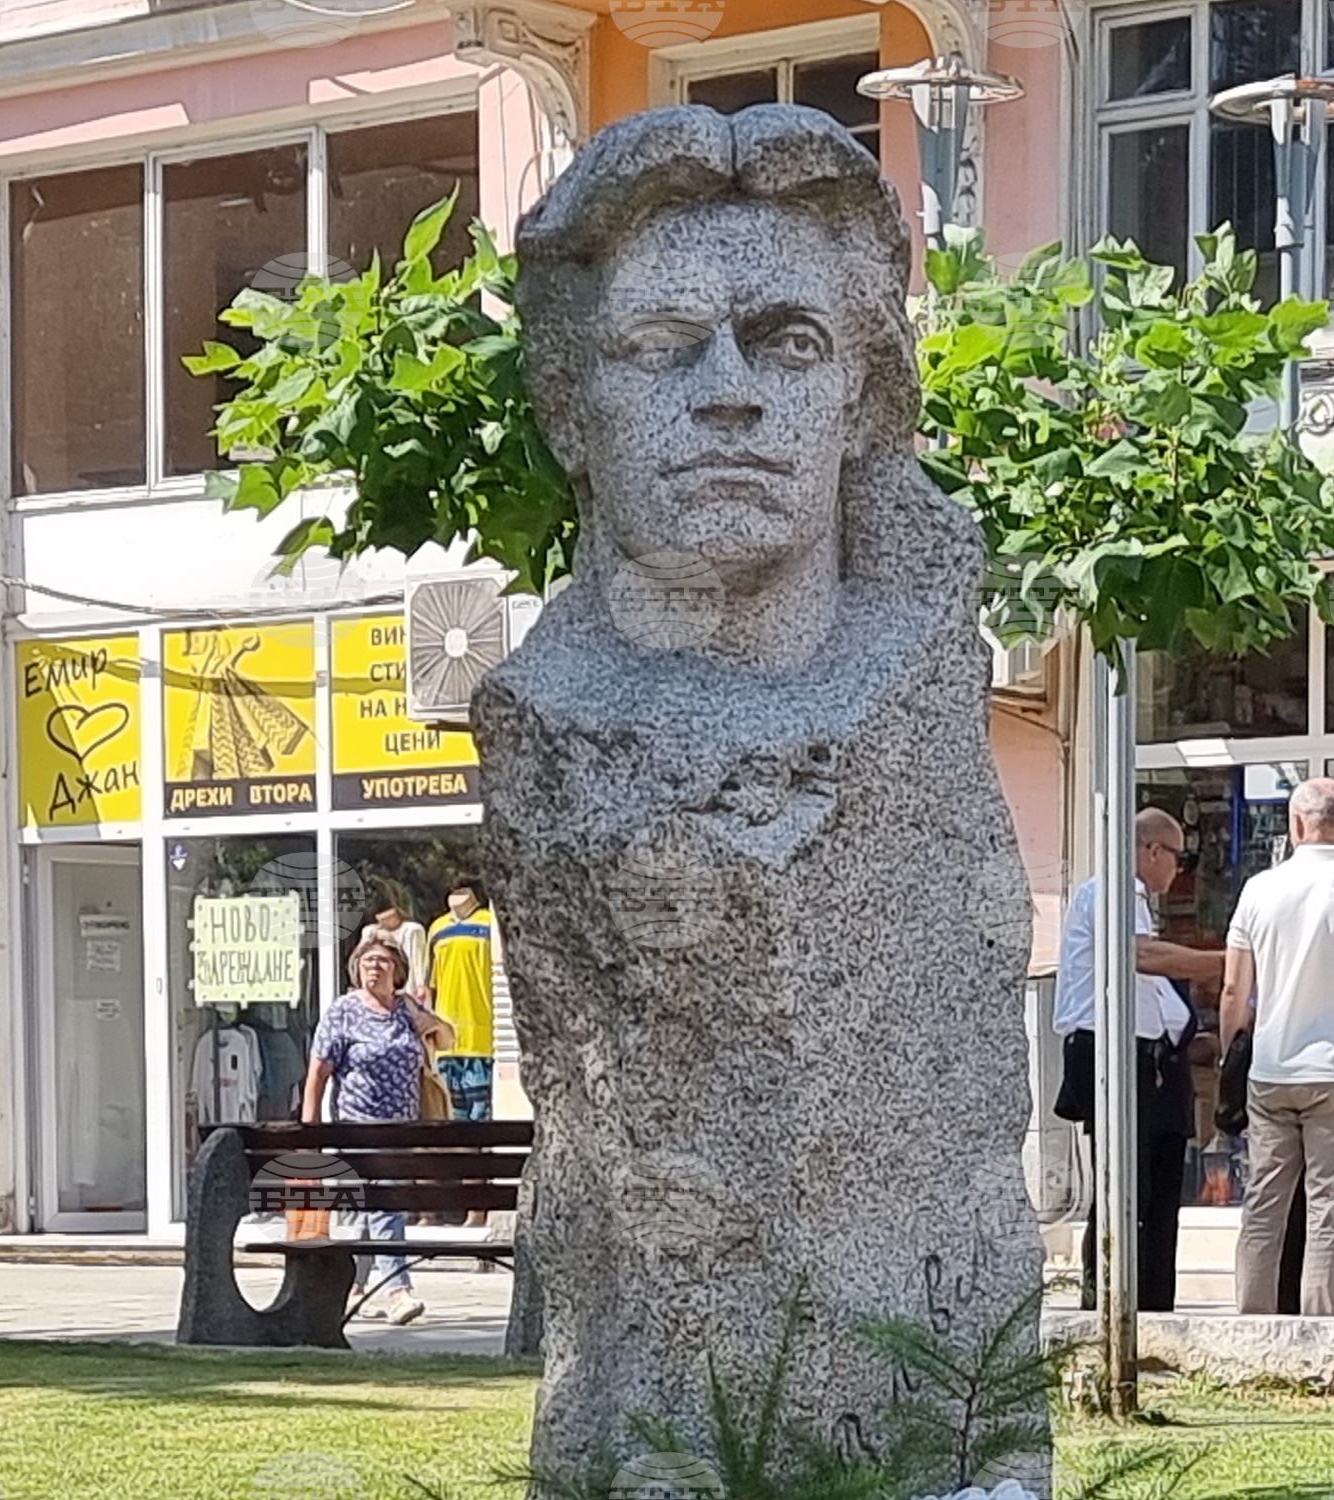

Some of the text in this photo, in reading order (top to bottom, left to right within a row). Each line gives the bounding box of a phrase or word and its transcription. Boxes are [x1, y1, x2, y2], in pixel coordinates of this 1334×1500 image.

[24, 647, 107, 698] Емир
[360, 699, 388, 719] НА
[384, 730, 441, 756] ЦЕНИ
[49, 760, 140, 821] Джан
[169, 773, 468, 813] ДРЕХИ ВТОРА УПОТРЕБА
[210, 902, 271, 944] НОВО
